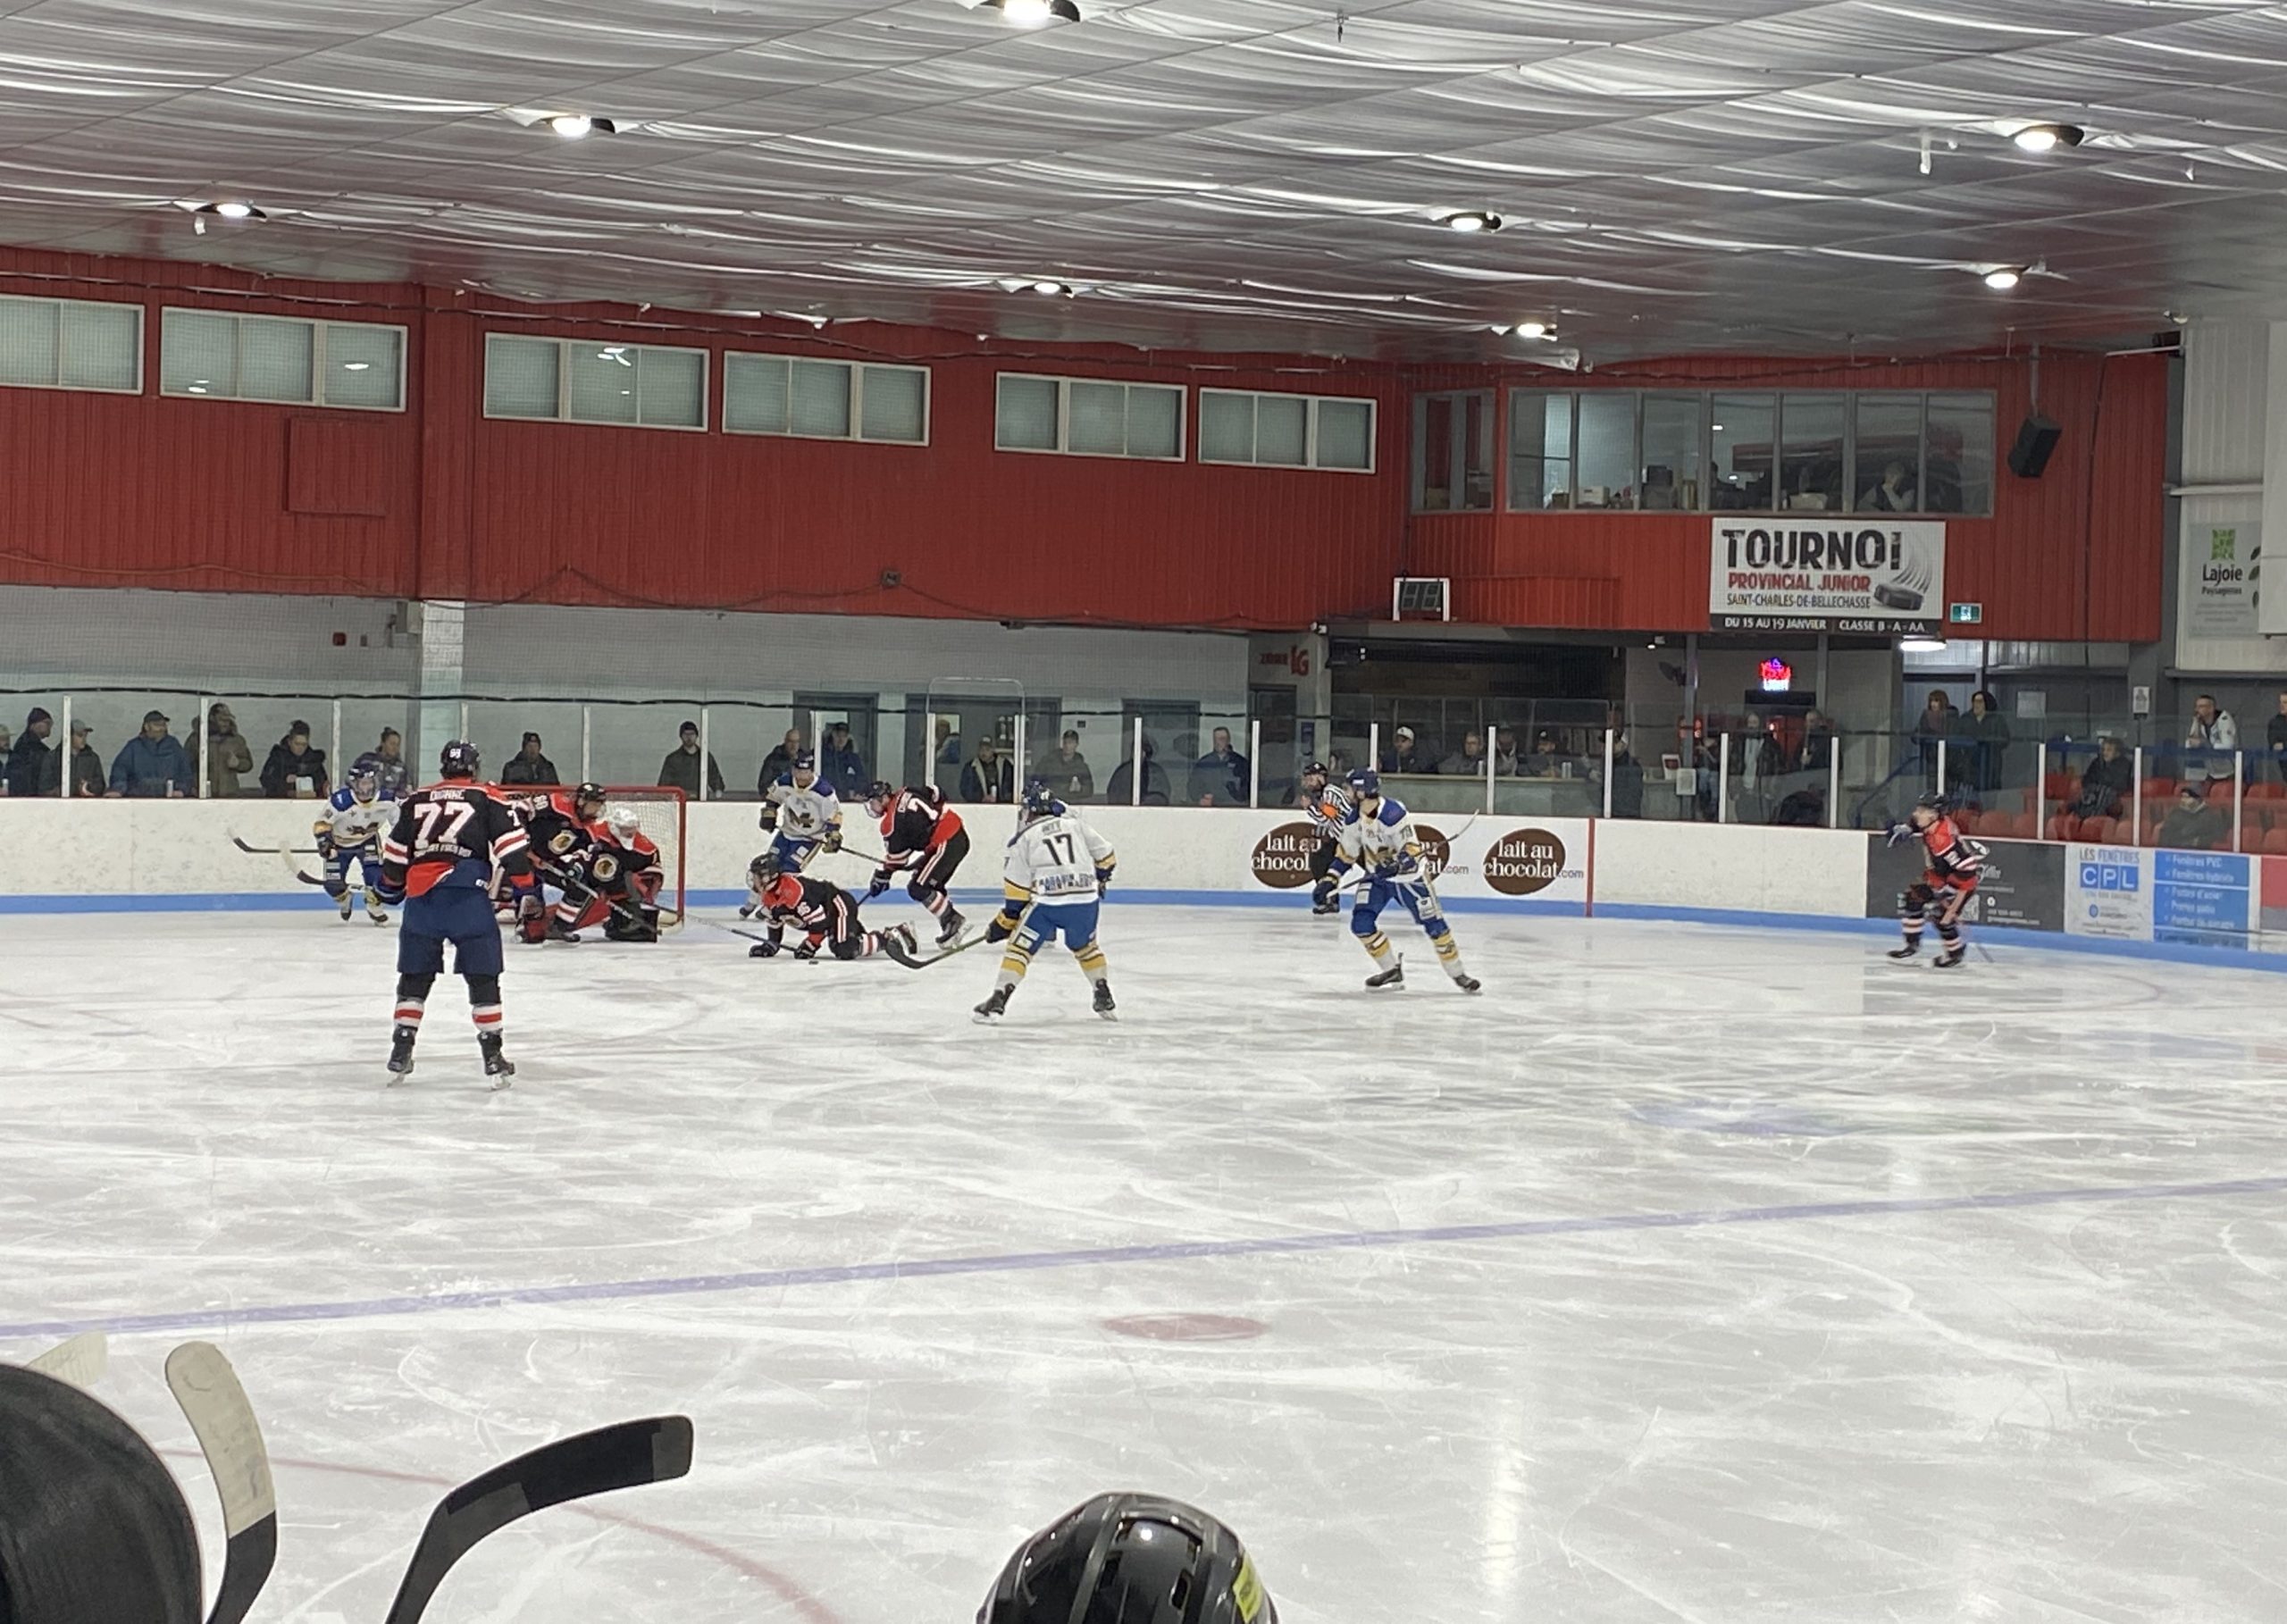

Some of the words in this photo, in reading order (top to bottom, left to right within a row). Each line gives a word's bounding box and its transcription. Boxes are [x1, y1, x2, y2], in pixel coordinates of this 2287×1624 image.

[1722, 528, 1902, 571] TOURNOI
[1728, 572, 1814, 591] PROVINCIAL
[1816, 573, 1872, 592] JUNIOR
[2202, 564, 2243, 586] Lajoie
[1724, 617, 1739, 628] DU
[1742, 618, 1754, 628] 15
[1755, 618, 1771, 629] AU
[1772, 618, 1784, 630] 19
[1786, 619, 1827, 631] JANVIER
[1839, 620, 1874, 632] CLASSE
[414, 801, 475, 850] 77
[1042, 833, 1076, 866] 17
[1265, 832, 1296, 852] lait
[1497, 839, 1529, 858] lait
[1530, 844, 1554, 859] au
[1251, 850, 1311, 872] chocol
[2082, 866, 2135, 889] CPL
